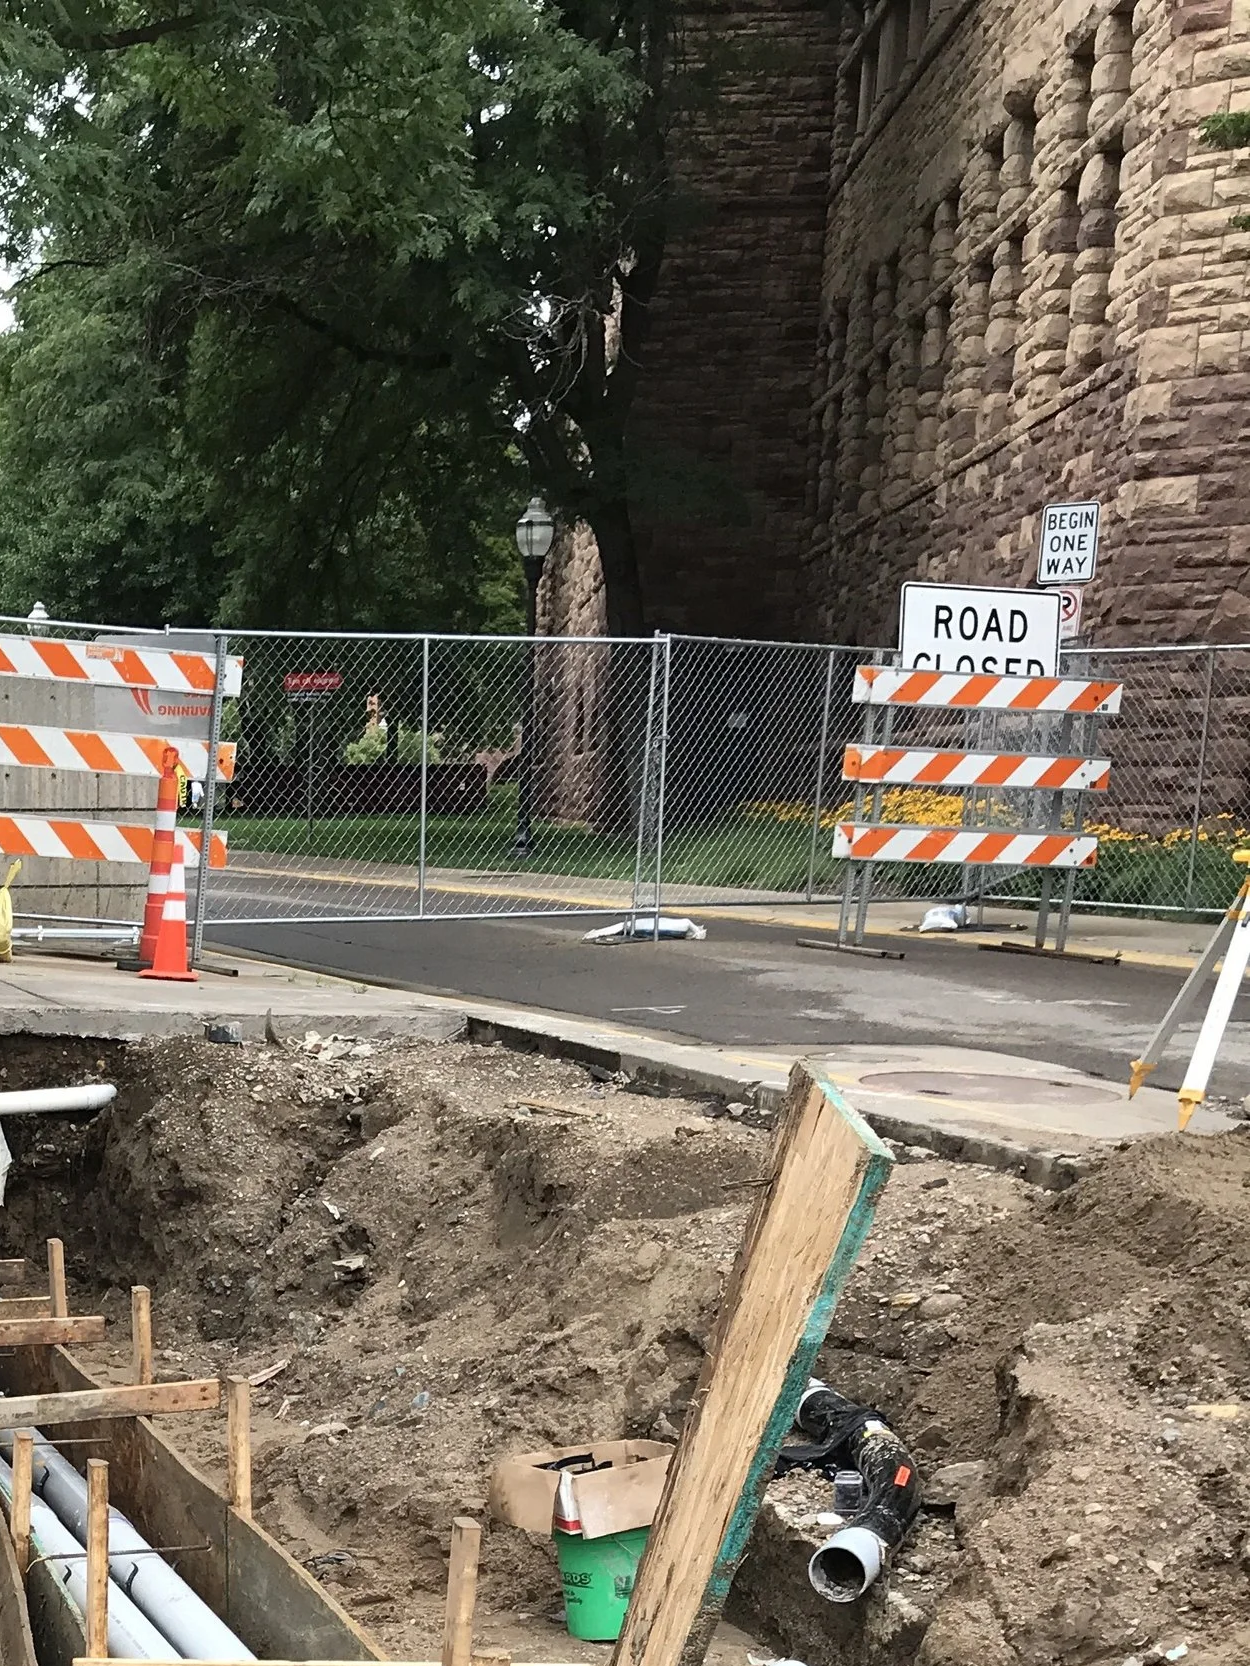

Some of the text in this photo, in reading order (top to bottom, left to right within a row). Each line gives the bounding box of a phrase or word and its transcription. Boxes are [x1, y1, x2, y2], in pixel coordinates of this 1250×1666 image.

[1047, 511, 1095, 530] BEGIN
[1049, 534, 1088, 553] ONE
[1046, 556, 1088, 575] WAY
[933, 605, 1029, 643] ROAD
